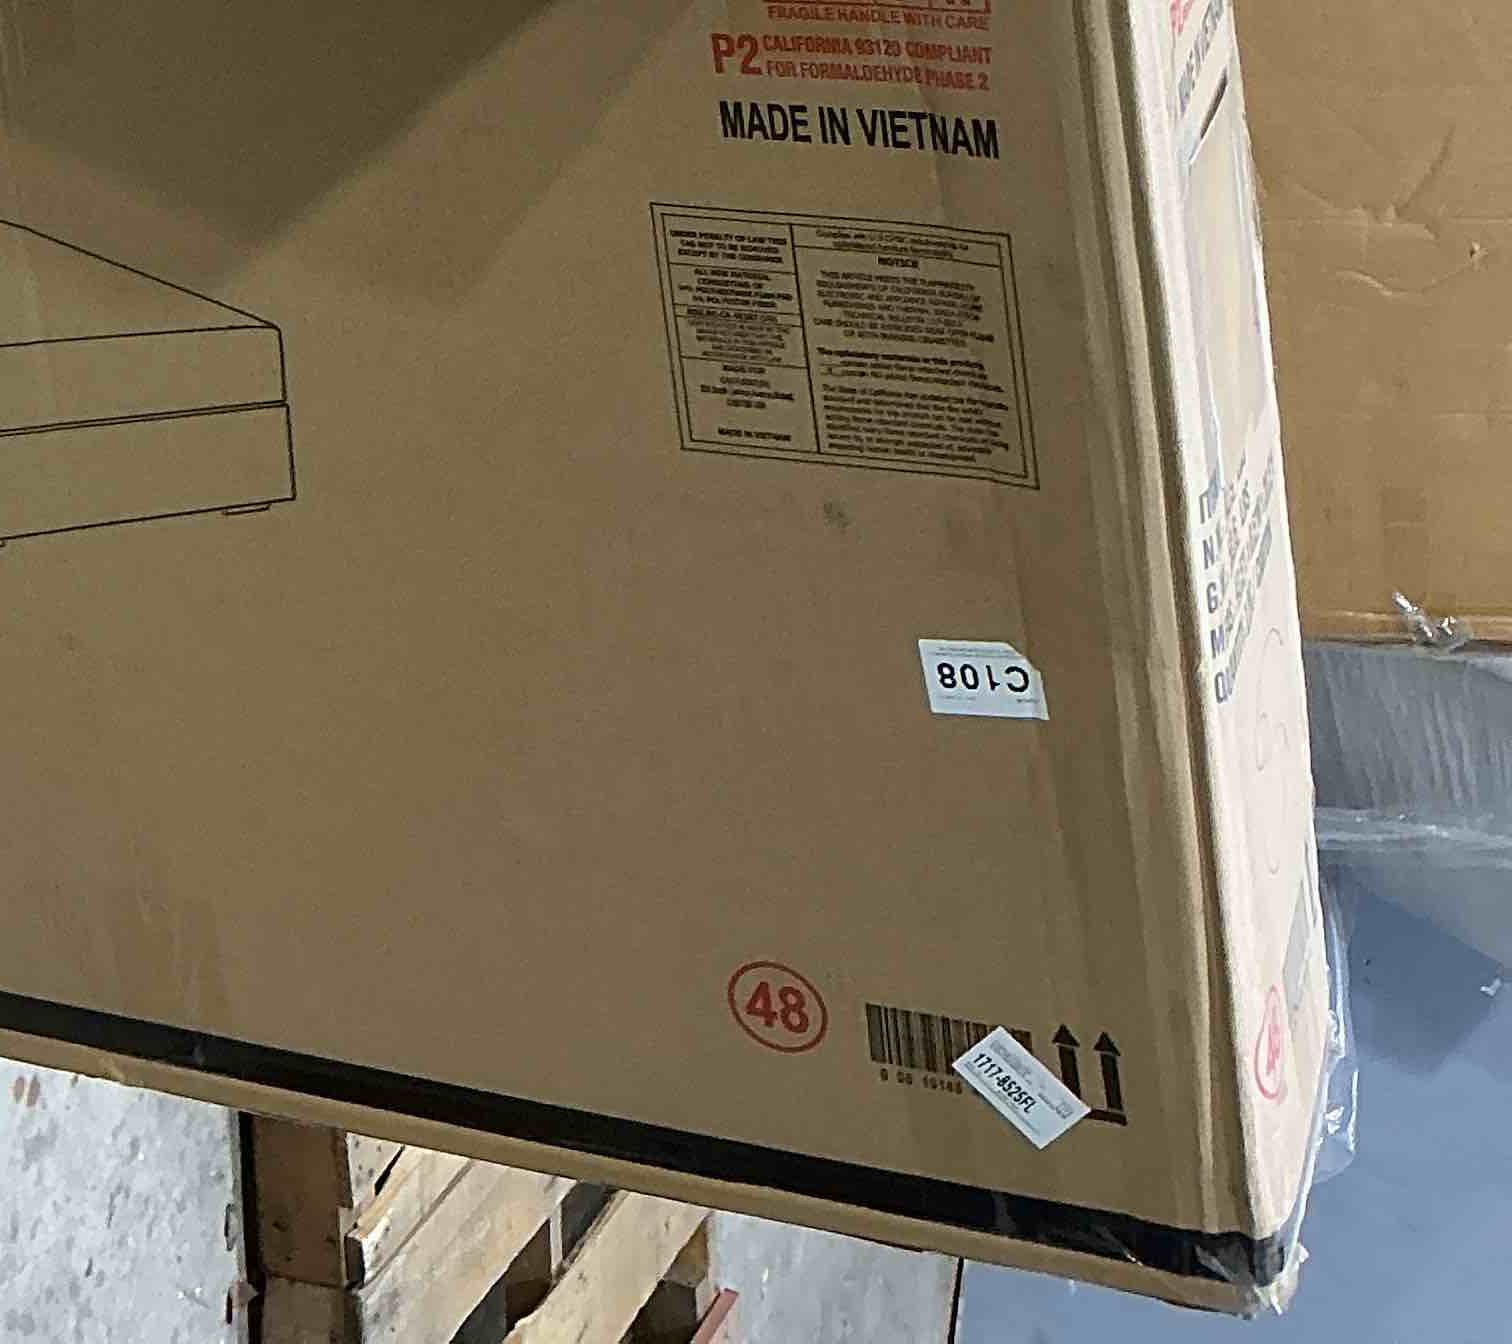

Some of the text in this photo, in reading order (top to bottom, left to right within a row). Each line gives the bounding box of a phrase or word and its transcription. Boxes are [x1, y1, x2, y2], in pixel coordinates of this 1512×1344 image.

[710, 32, 762, 76] P2
[761, 33, 993, 65] CALIFORNIA 93120 COMPLIANT
[765, 60, 799, 79] FOR
[976, 71, 991, 91] 2
[718, 100, 1001, 160] MADE IN VIETNAM
[937, 662, 1030, 693] C108
[745, 981, 810, 1035] 48
